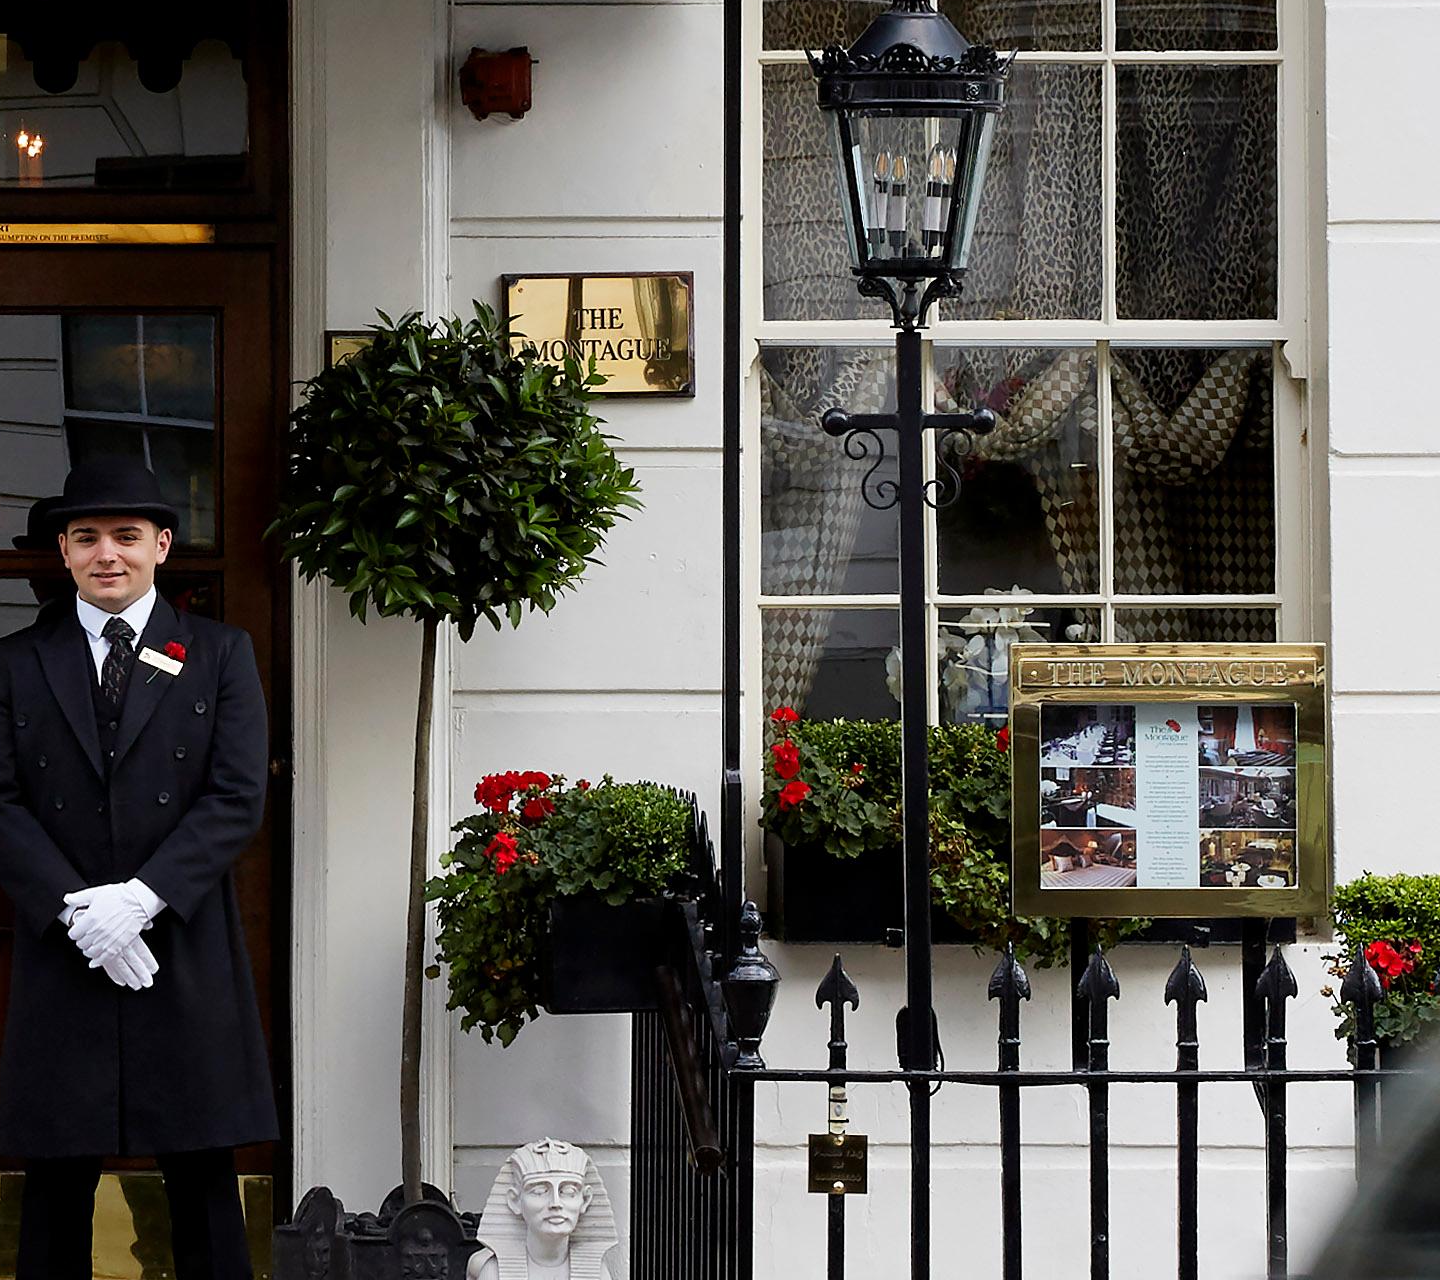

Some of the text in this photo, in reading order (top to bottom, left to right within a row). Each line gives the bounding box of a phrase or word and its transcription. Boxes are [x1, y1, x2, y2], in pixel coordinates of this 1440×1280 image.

[574, 307, 625, 330] THE
[533, 336, 672, 362] MONTAGUE
[1046, 662, 1106, 687] THE
[1121, 662, 1289, 687] MONTAGUE
